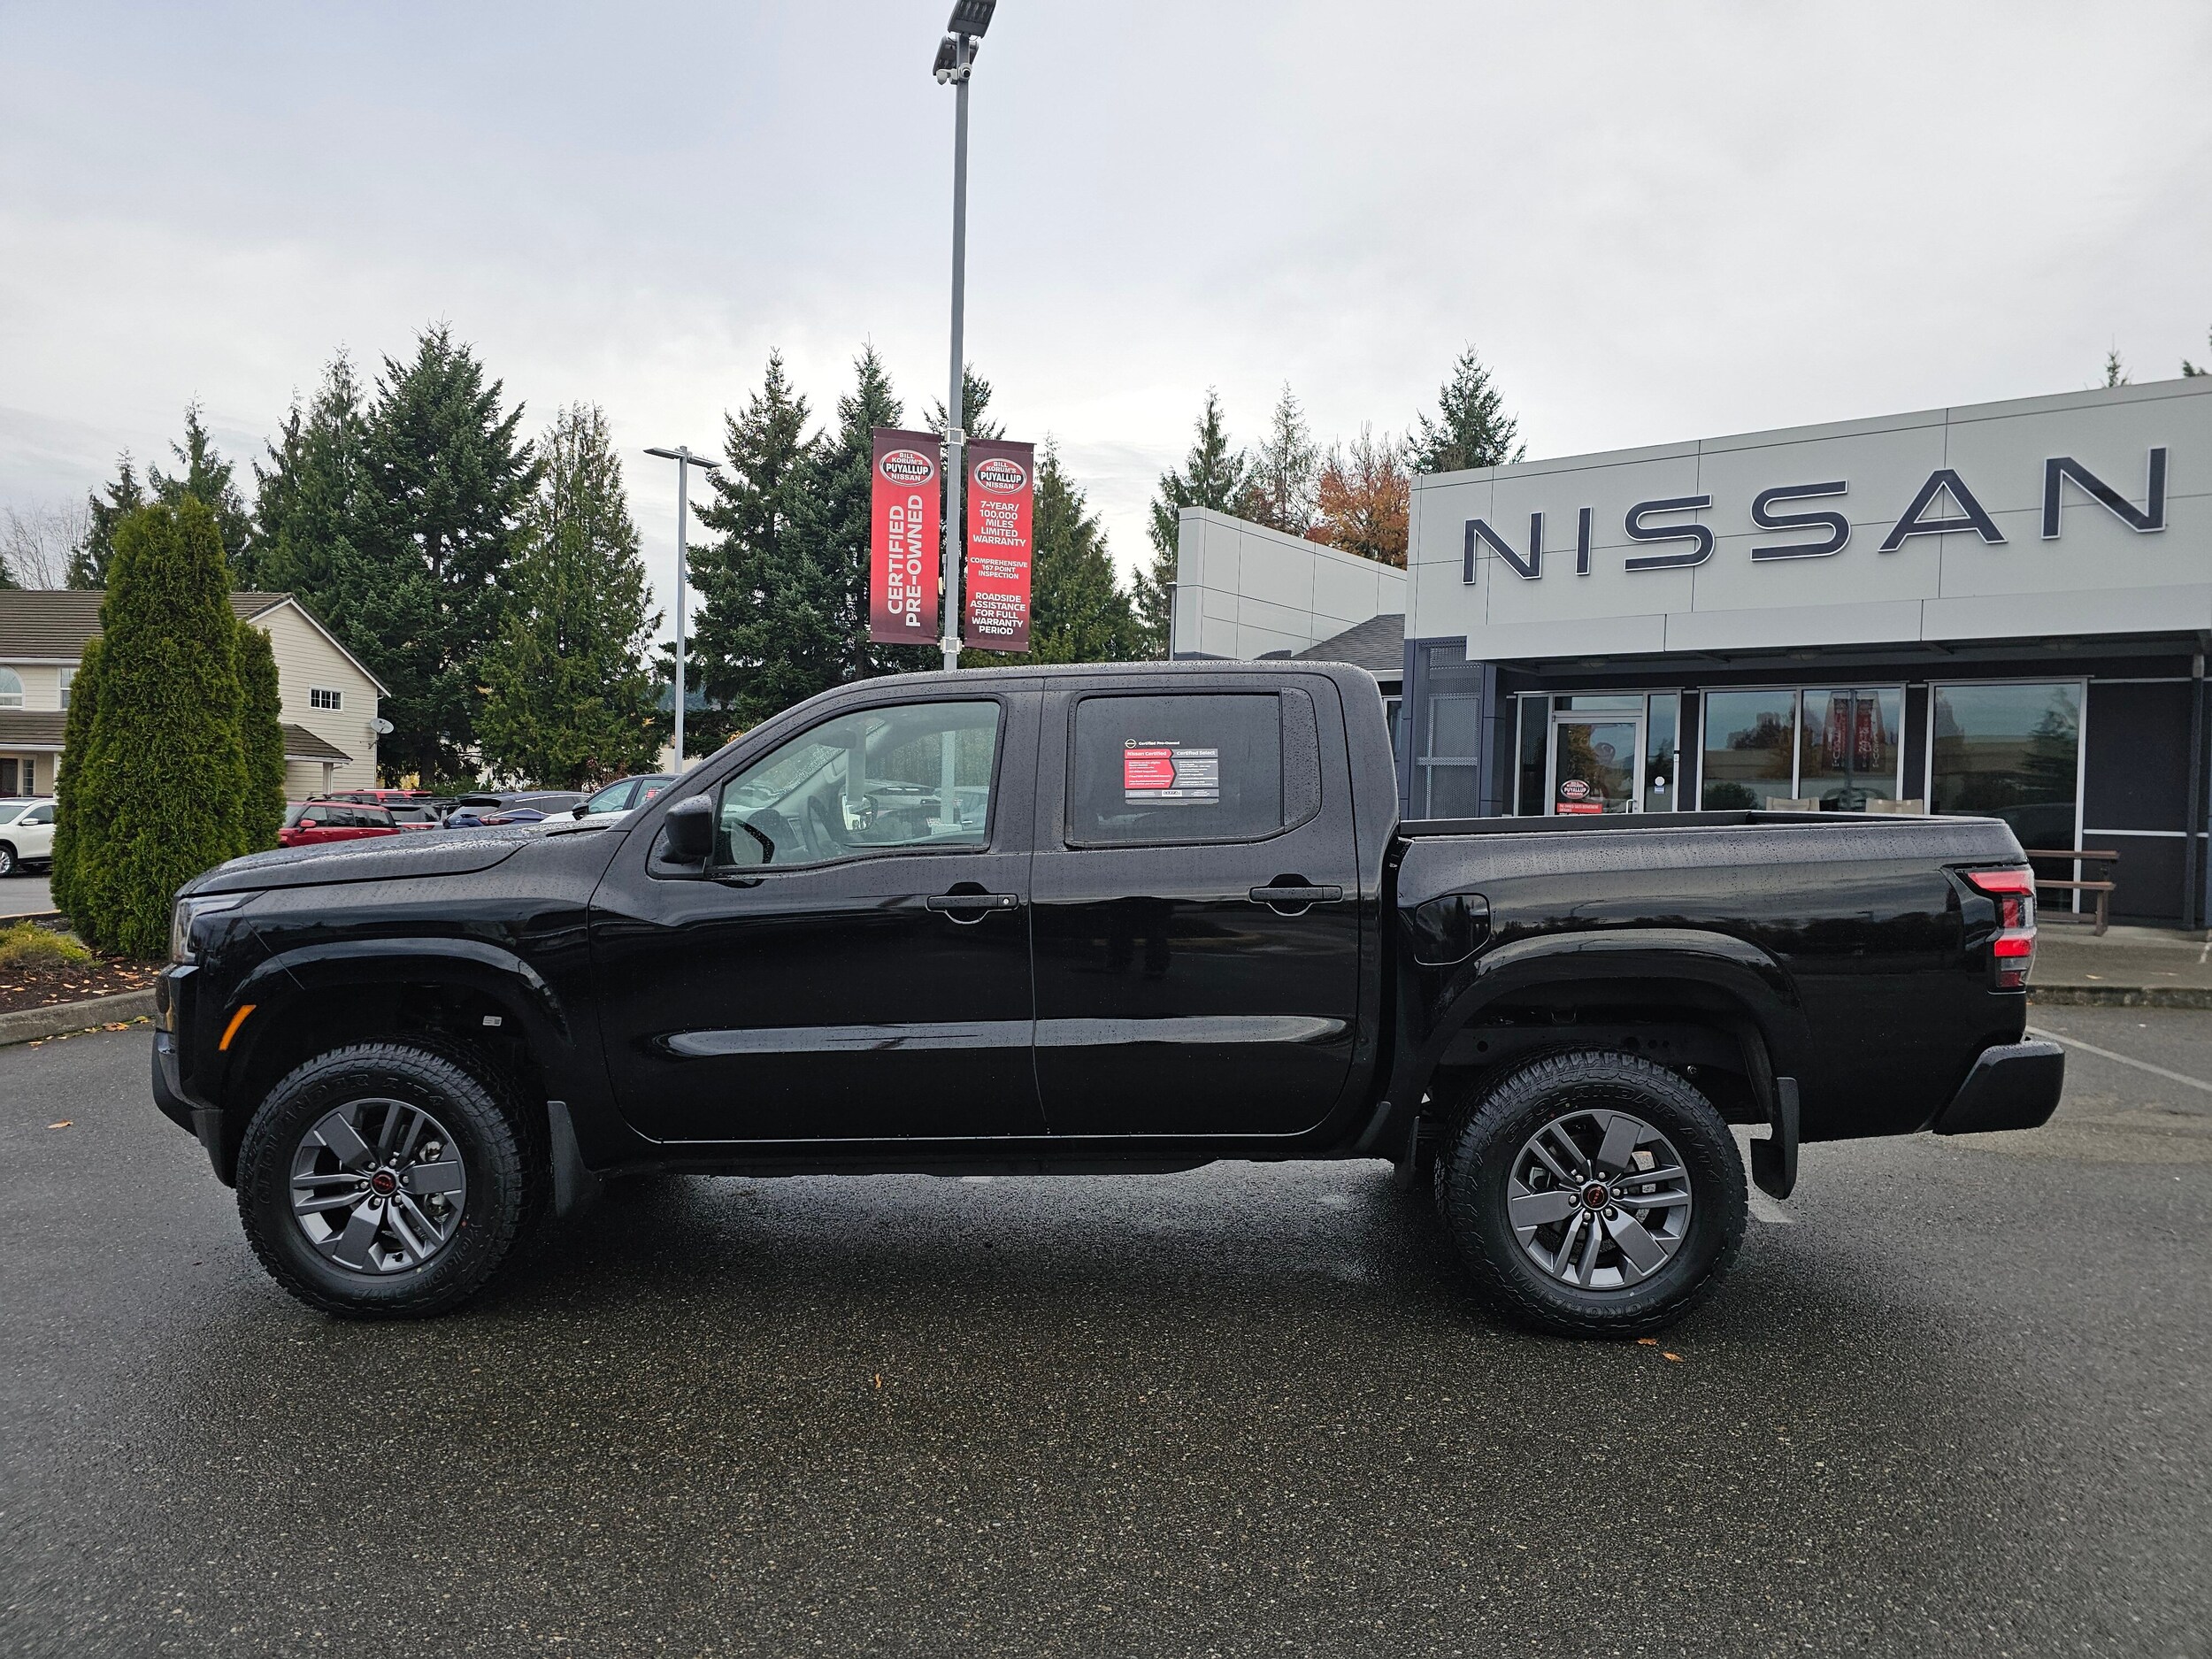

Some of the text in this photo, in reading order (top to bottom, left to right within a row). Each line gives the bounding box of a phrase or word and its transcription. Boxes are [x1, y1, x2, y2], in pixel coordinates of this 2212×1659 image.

[886, 463, 929, 475] PUYALLUP
[980, 472, 1022, 484] PUYALLUP
[986, 481, 1015, 490] NISSAN
[980, 501, 1019, 512] 7-YEAR/
[979, 510, 1018, 520] 100,000
[1463, 447, 2168, 585] NISSAN
[986, 518, 1014, 528] MILES
[981, 526, 1018, 537] LIMITED
[972, 534, 1026, 547] WARRANTY
[887, 505, 904, 615] CERTIFIED
[905, 495, 923, 627] PRE-OWNED
[970, 557, 1028, 568] COMPREHENSIVE
[978, 571, 1019, 580] INSPECTION
[975, 592, 1022, 603] ROADSIDE
[970, 600, 1026, 611] ASSISTANCE
[975, 609, 1018, 619] FOR FULL
[972, 617, 1024, 627] WARRANTY
[979, 626, 1014, 635] PERIOD
